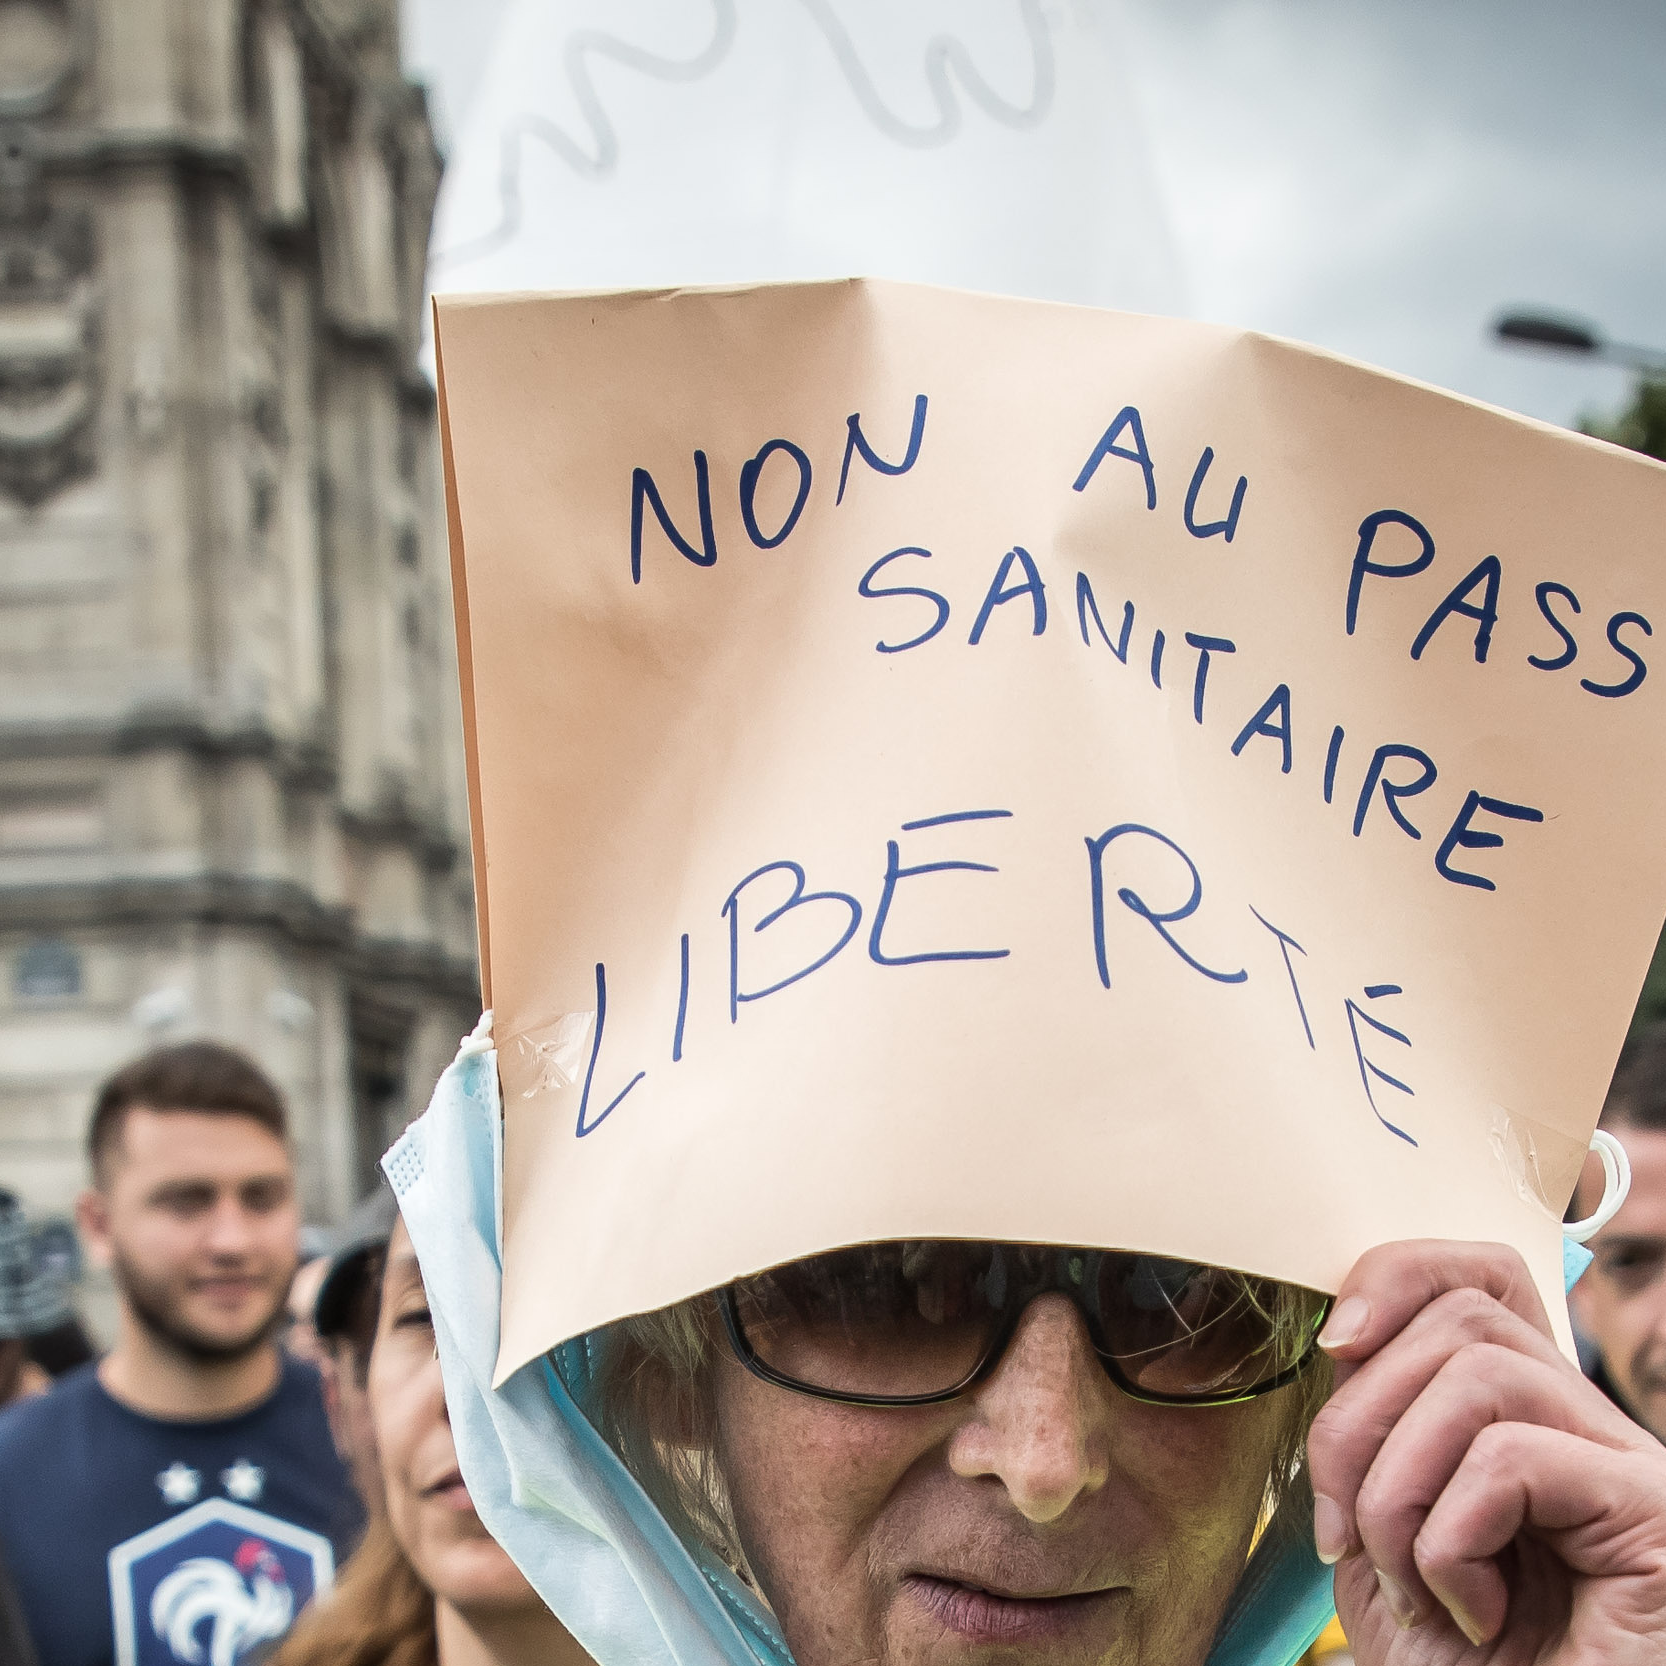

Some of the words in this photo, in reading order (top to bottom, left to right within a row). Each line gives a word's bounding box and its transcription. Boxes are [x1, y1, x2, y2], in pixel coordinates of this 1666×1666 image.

[632, 394, 928, 583] NON
[1073, 406, 1247, 542] AU
[1347, 510, 1652, 697] PASS
[858, 546, 1543, 890] SANITAIRE
[575, 810, 1417, 1145] LIBERTÉ
